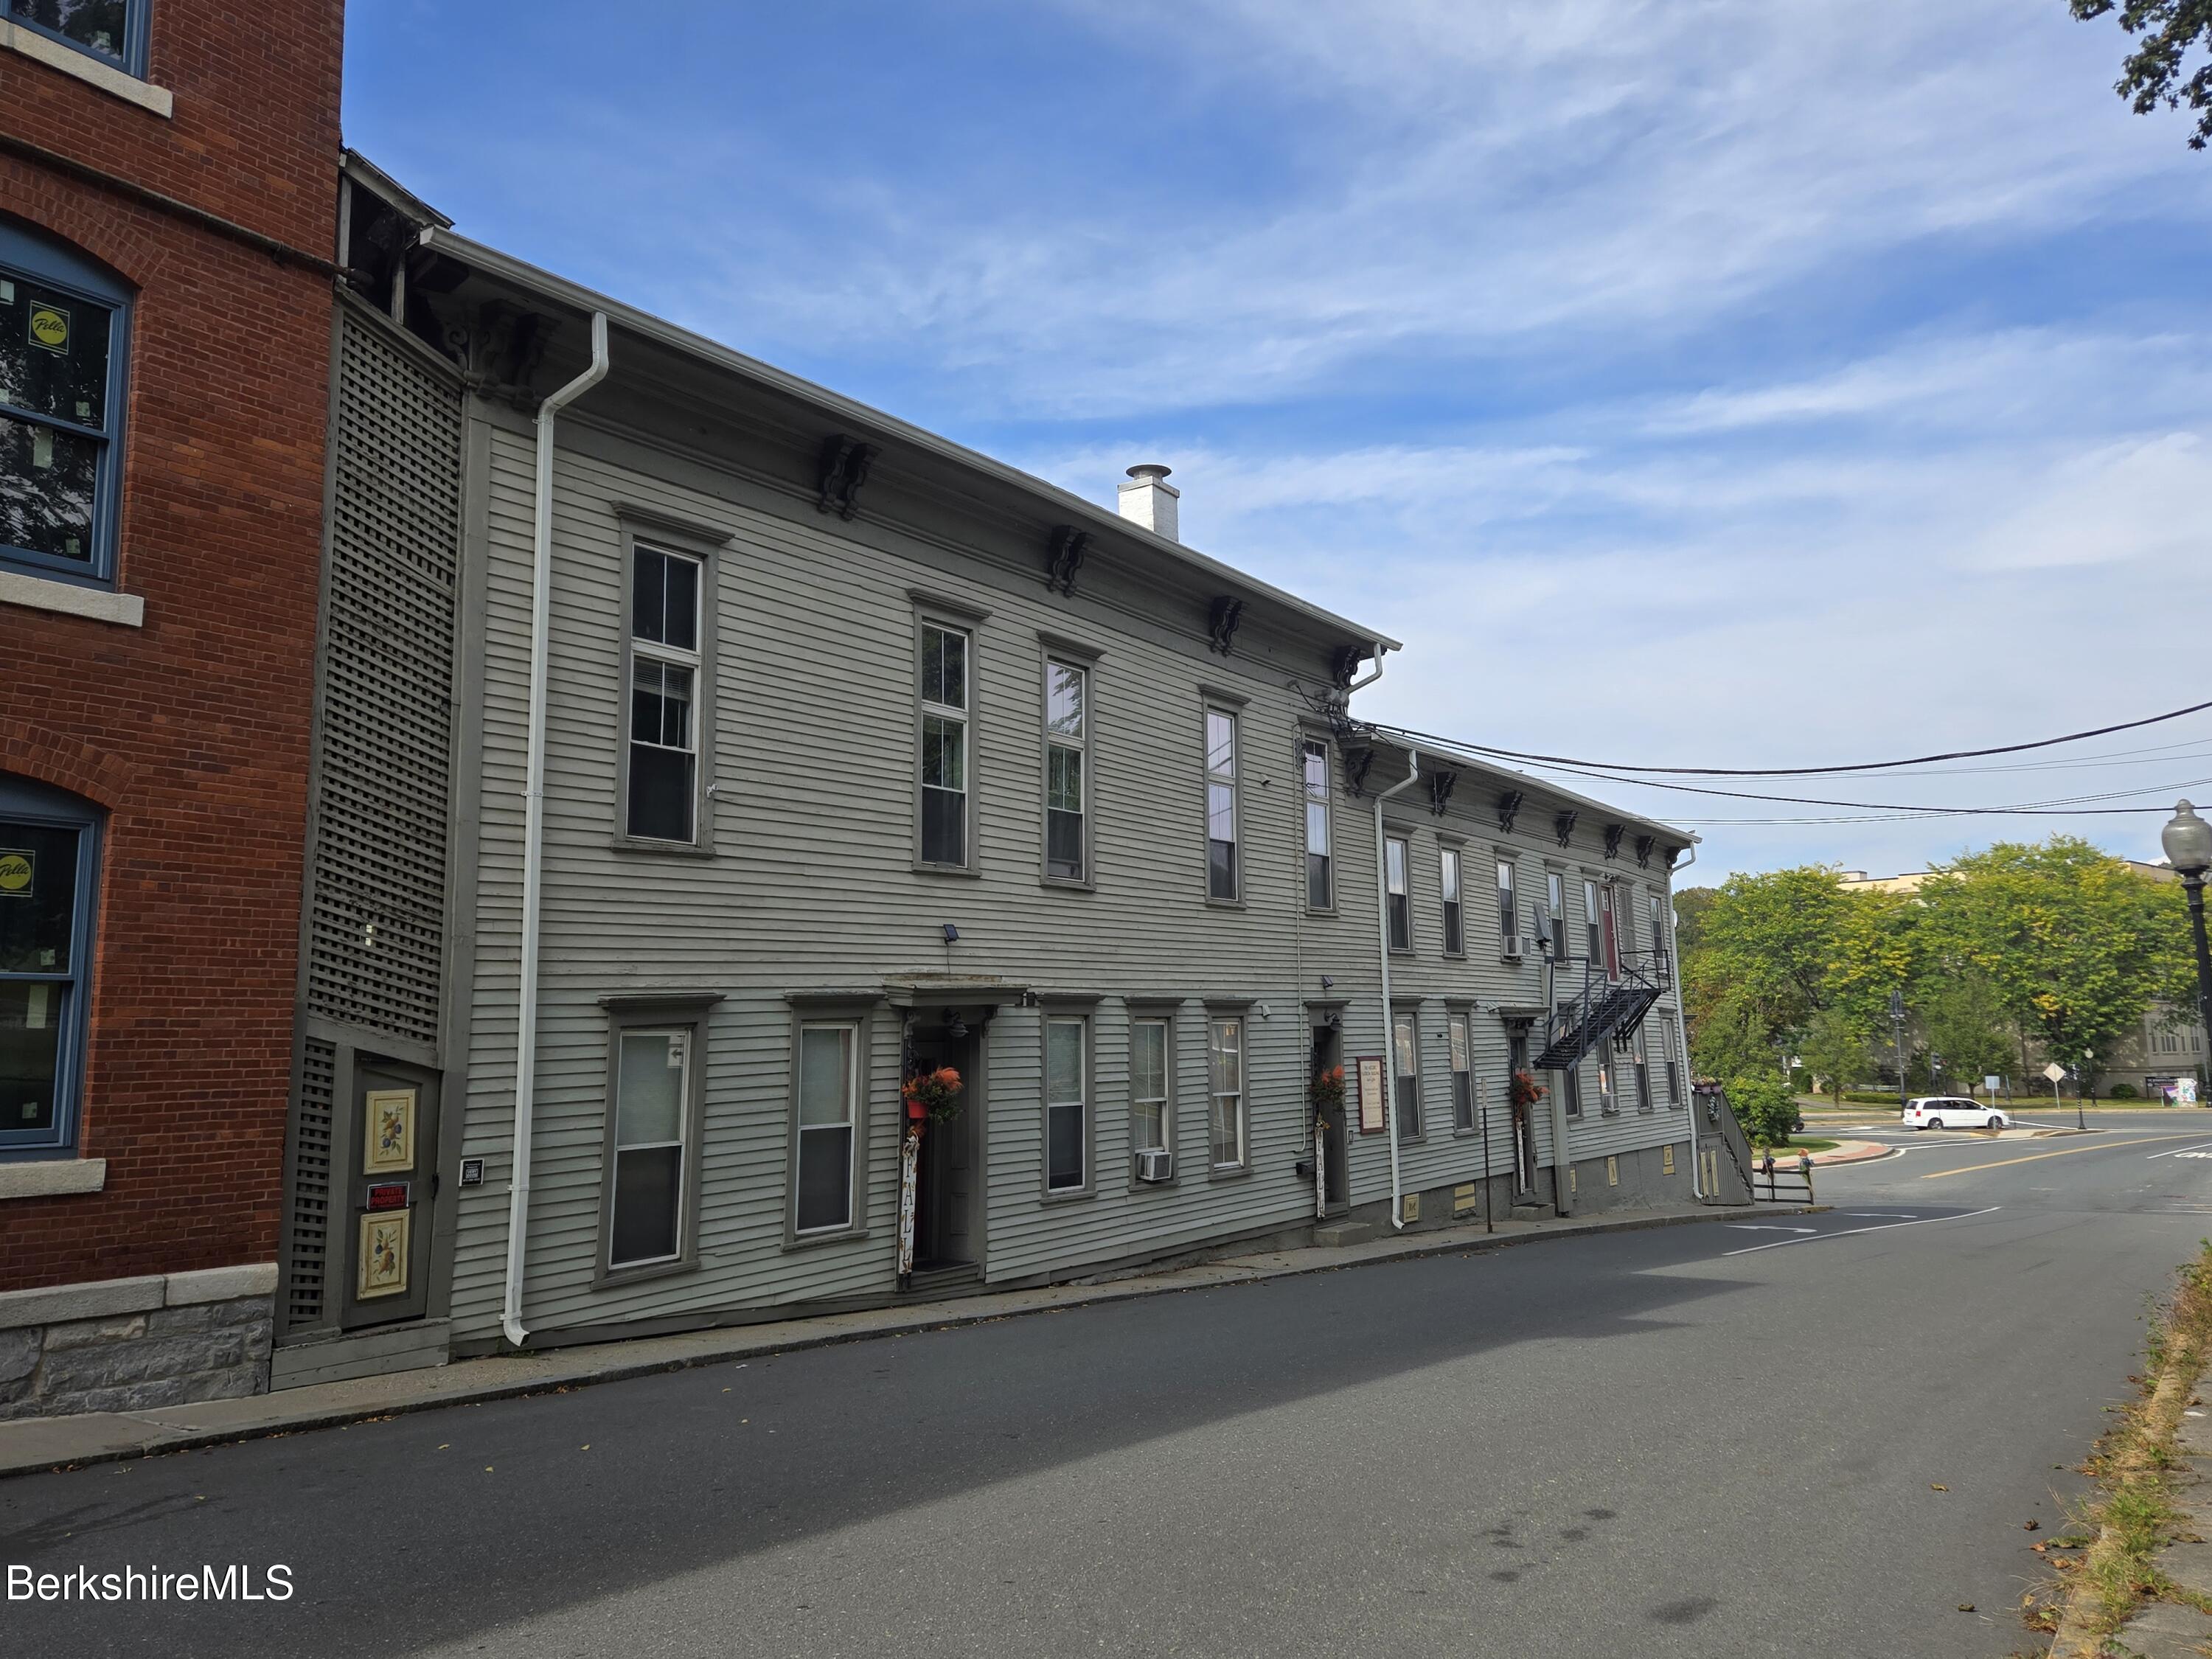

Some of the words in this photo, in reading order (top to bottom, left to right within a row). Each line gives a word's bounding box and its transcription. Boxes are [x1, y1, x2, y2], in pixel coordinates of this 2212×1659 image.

[35, 319, 65, 333] Pella
[0, 863, 29, 877] Pella
[371, 1194, 406, 1205] PROPERTY
